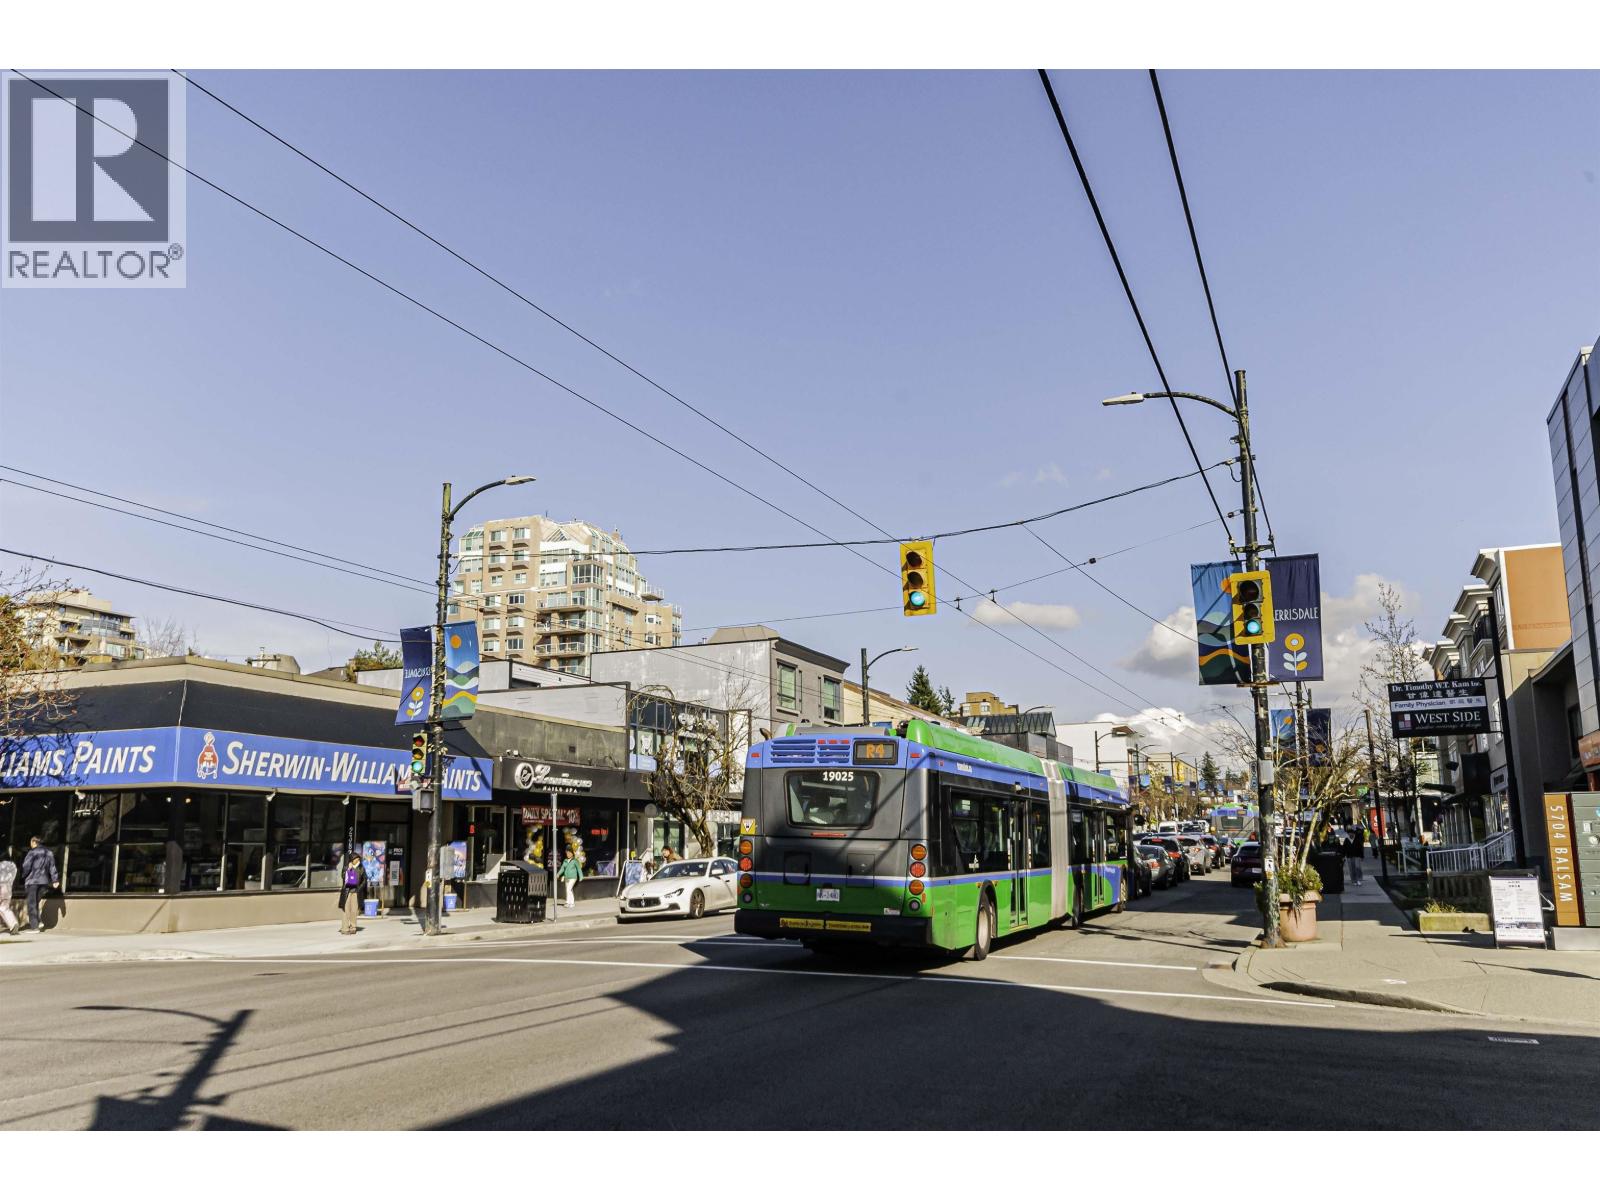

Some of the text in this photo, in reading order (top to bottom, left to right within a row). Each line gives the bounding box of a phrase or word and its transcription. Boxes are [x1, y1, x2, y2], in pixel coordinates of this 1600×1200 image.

[1275, 607, 1319, 621] ERRISDALE
[1405, 683, 1434, 692] Timothy
[1452, 680, 1470, 688] Kam
[1394, 701, 1415, 709] Family
[1416, 700, 1446, 709] Physician
[1414, 711, 1481, 724] WEST SIDE
[70, 741, 156, 774] PAINTS
[866, 743, 885, 759] R4
[222, 741, 482, 792] SHERWIN-WILLIAM AINTS
[822, 772, 854, 782] 19025
[1550, 805, 1574, 902] 5704 BALSAM
